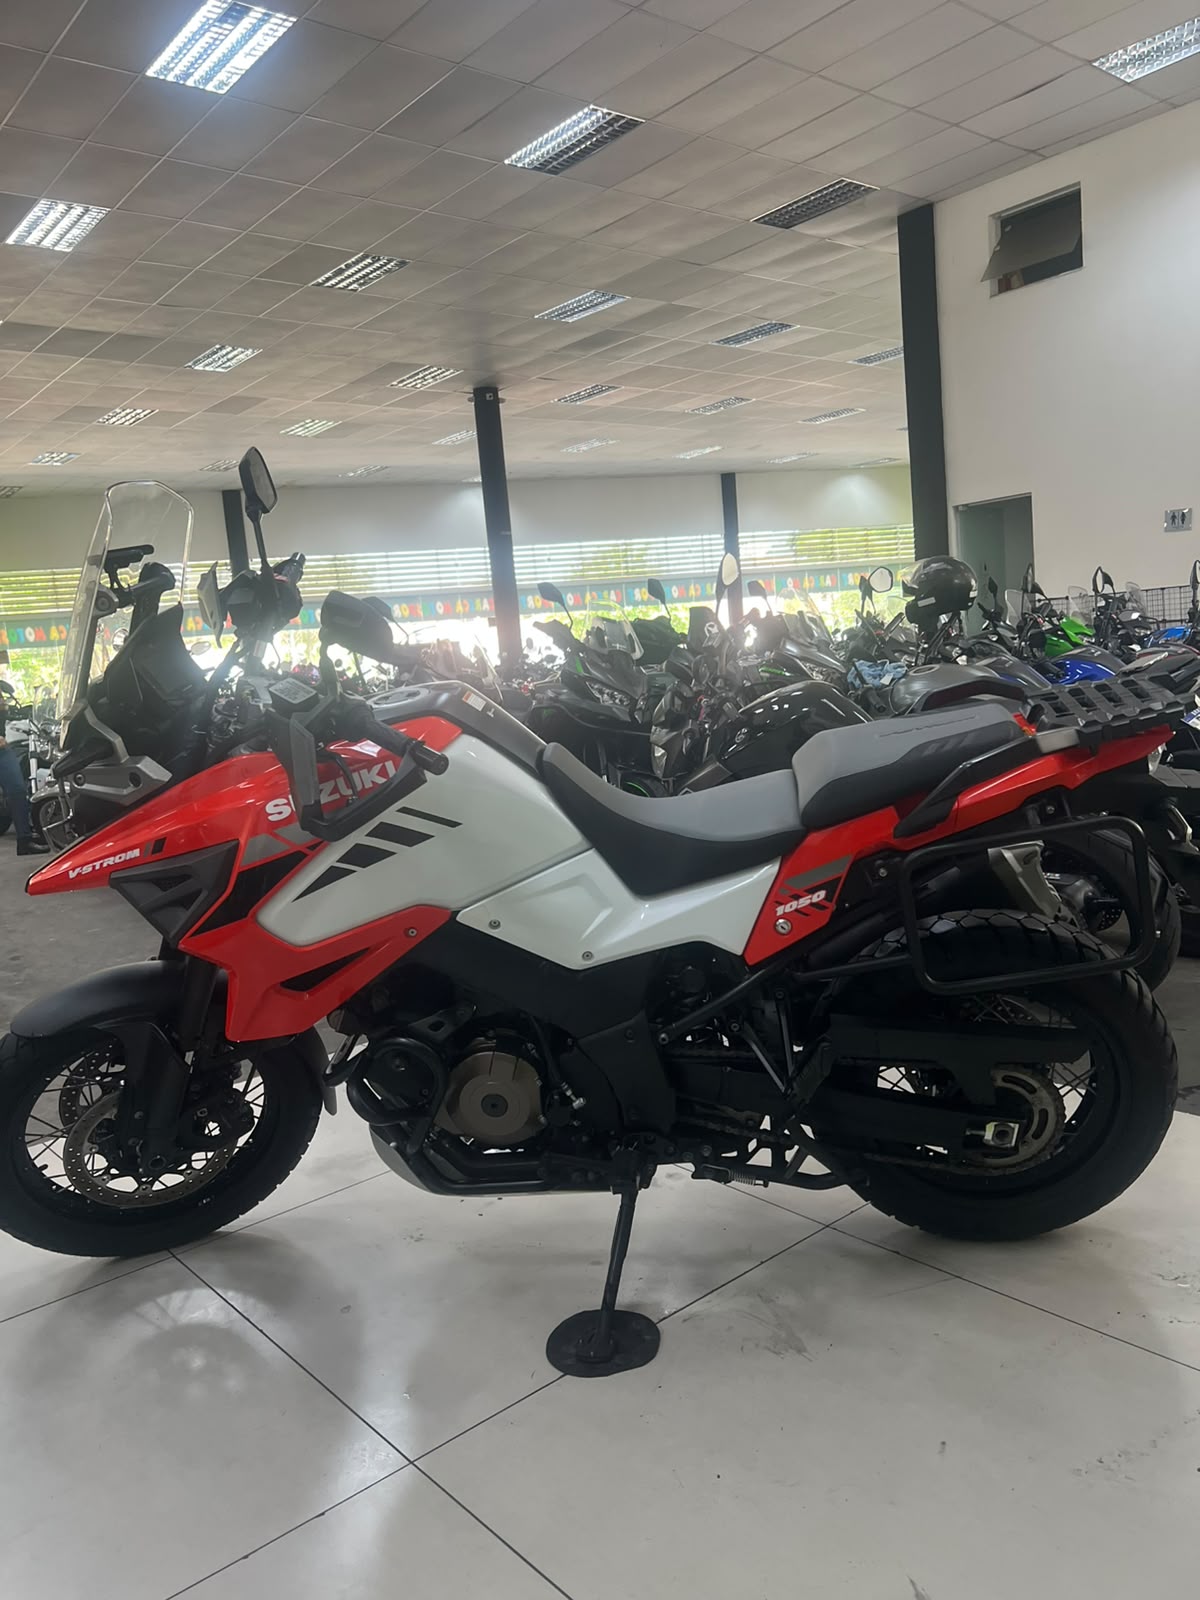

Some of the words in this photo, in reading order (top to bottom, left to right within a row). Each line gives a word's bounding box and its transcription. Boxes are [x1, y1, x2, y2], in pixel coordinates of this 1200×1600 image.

[265, 760, 397, 821] SZUKI
[68, 848, 140, 879] V-STROM
[775, 890, 827, 916] 1050
